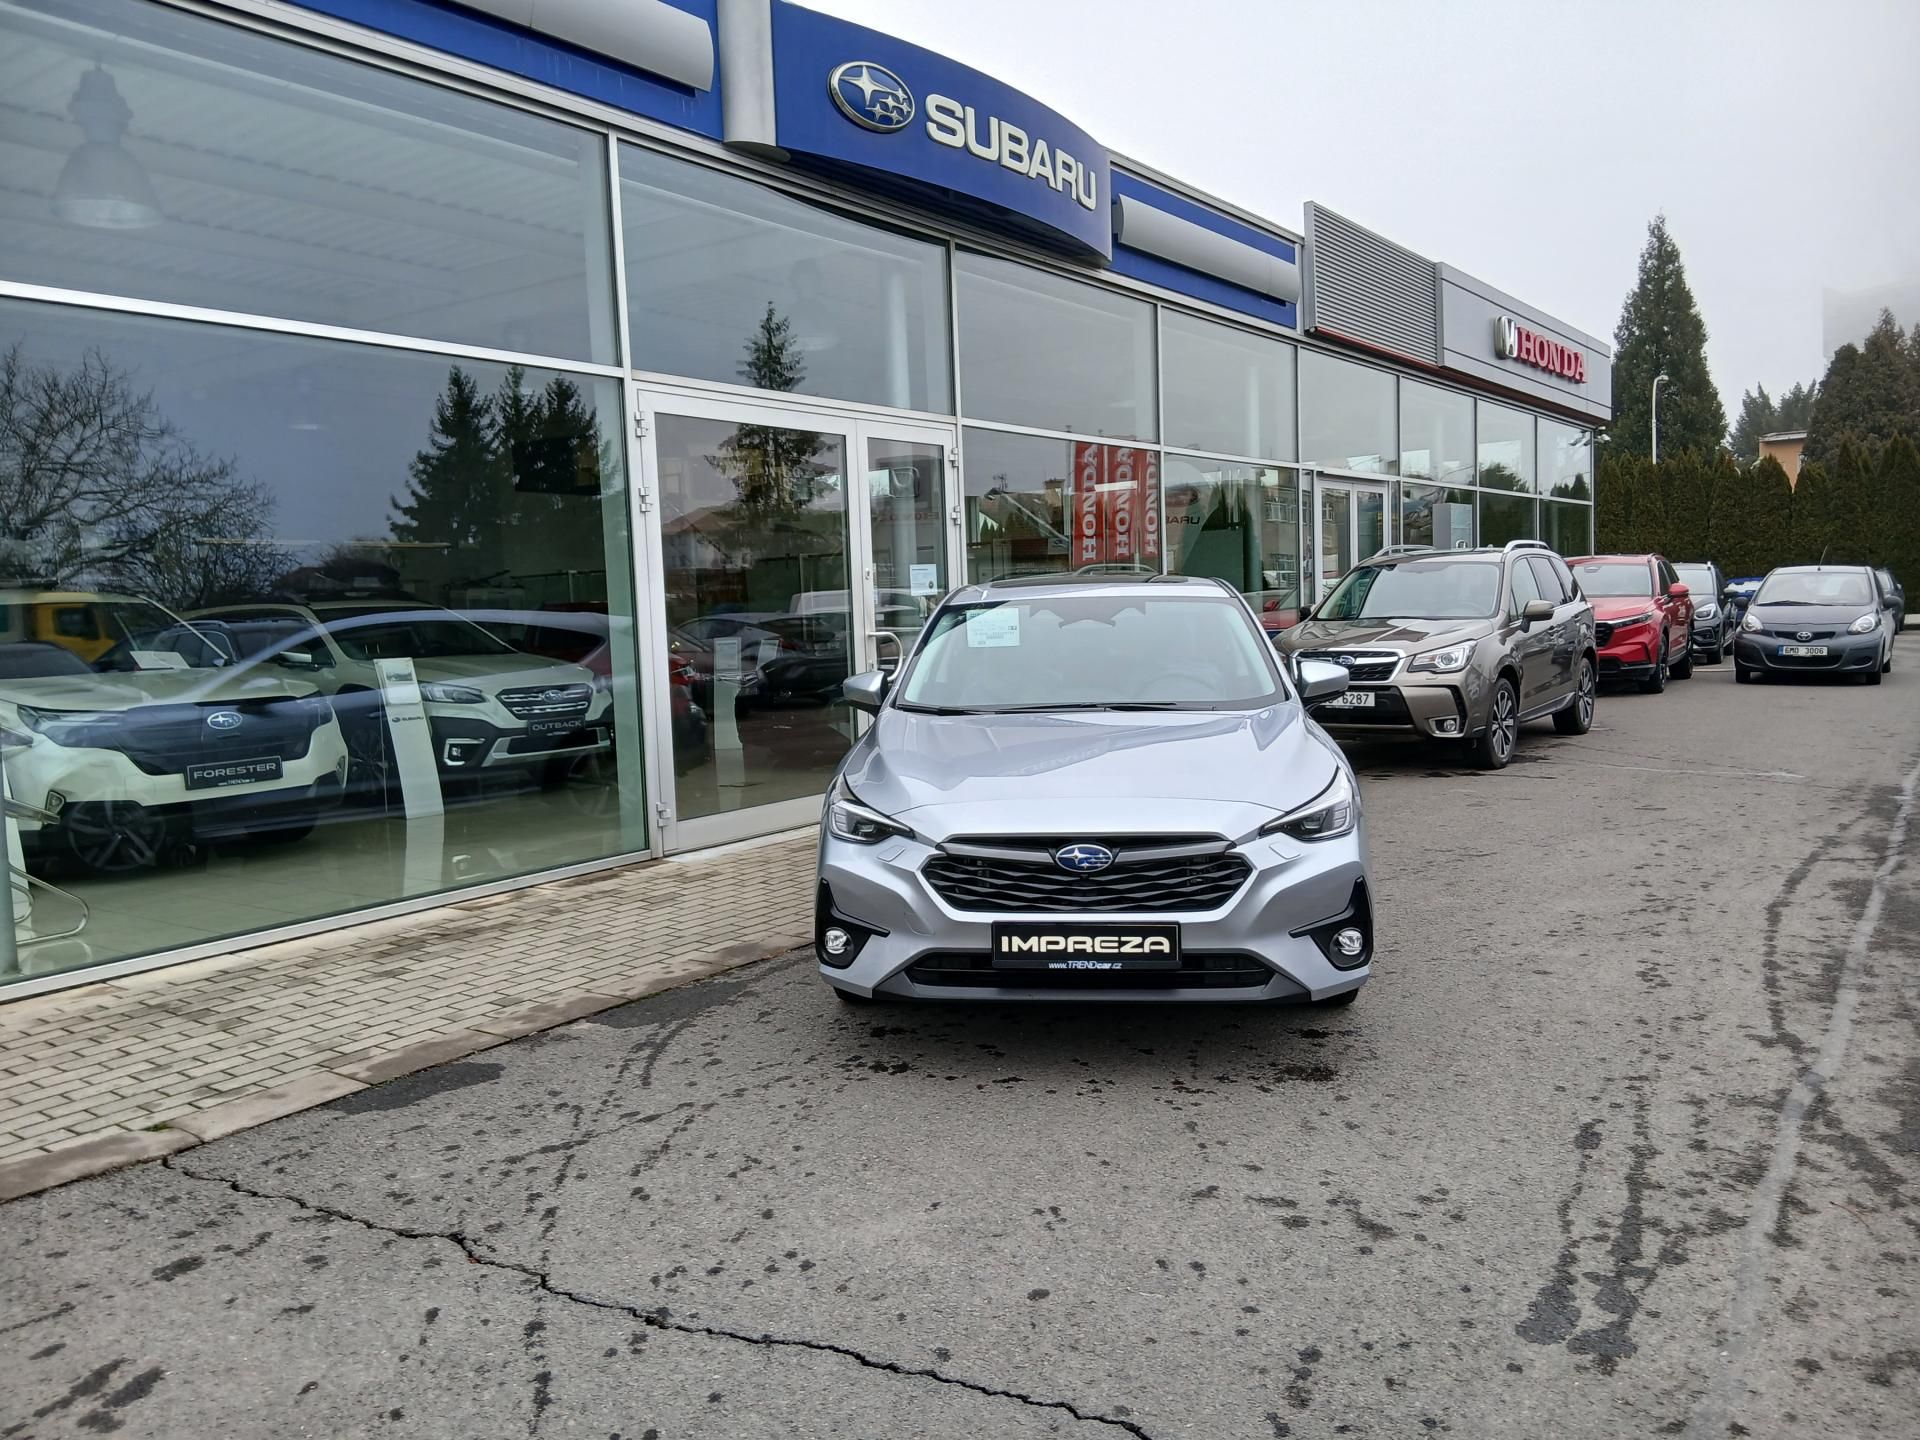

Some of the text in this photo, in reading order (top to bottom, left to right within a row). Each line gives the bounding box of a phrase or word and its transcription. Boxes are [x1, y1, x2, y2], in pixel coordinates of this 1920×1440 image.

[925, 93, 1096, 211] SUBARU
[1517, 326, 1587, 383] HONDA
[1082, 444, 1098, 561] HONDA
[1115, 448, 1133, 556] HONDA
[1342, 693, 1370, 705] 6287
[532, 720, 582, 731] OUTBACK
[193, 762, 277, 780] FORESTER
[1001, 936, 1170, 953] IMPREZA
[1048, 960, 1123, 969] www.TRENDcar.cz
